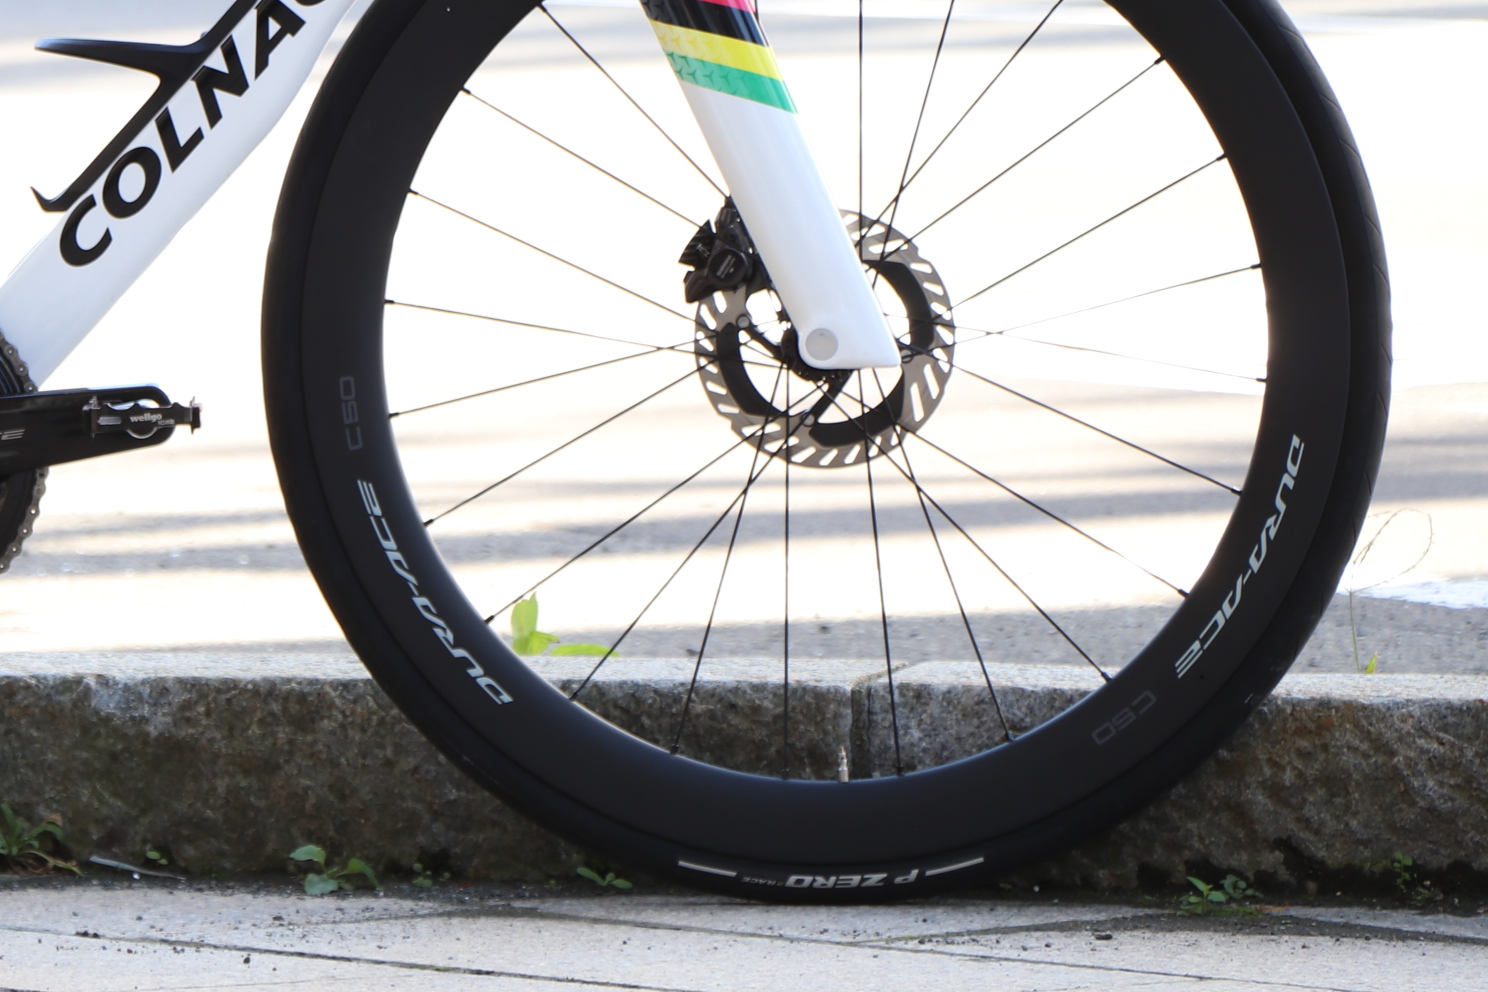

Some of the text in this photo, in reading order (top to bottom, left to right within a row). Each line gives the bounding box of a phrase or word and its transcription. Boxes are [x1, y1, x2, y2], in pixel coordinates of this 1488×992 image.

[129, 412, 162, 423] wellgo
[340, 376, 514, 705] DURA-ACE C50
[1091, 434, 1305, 745] DURA-ACE C50
[785, 874, 889, 889] ZERO
[894, 869, 920, 885] P
